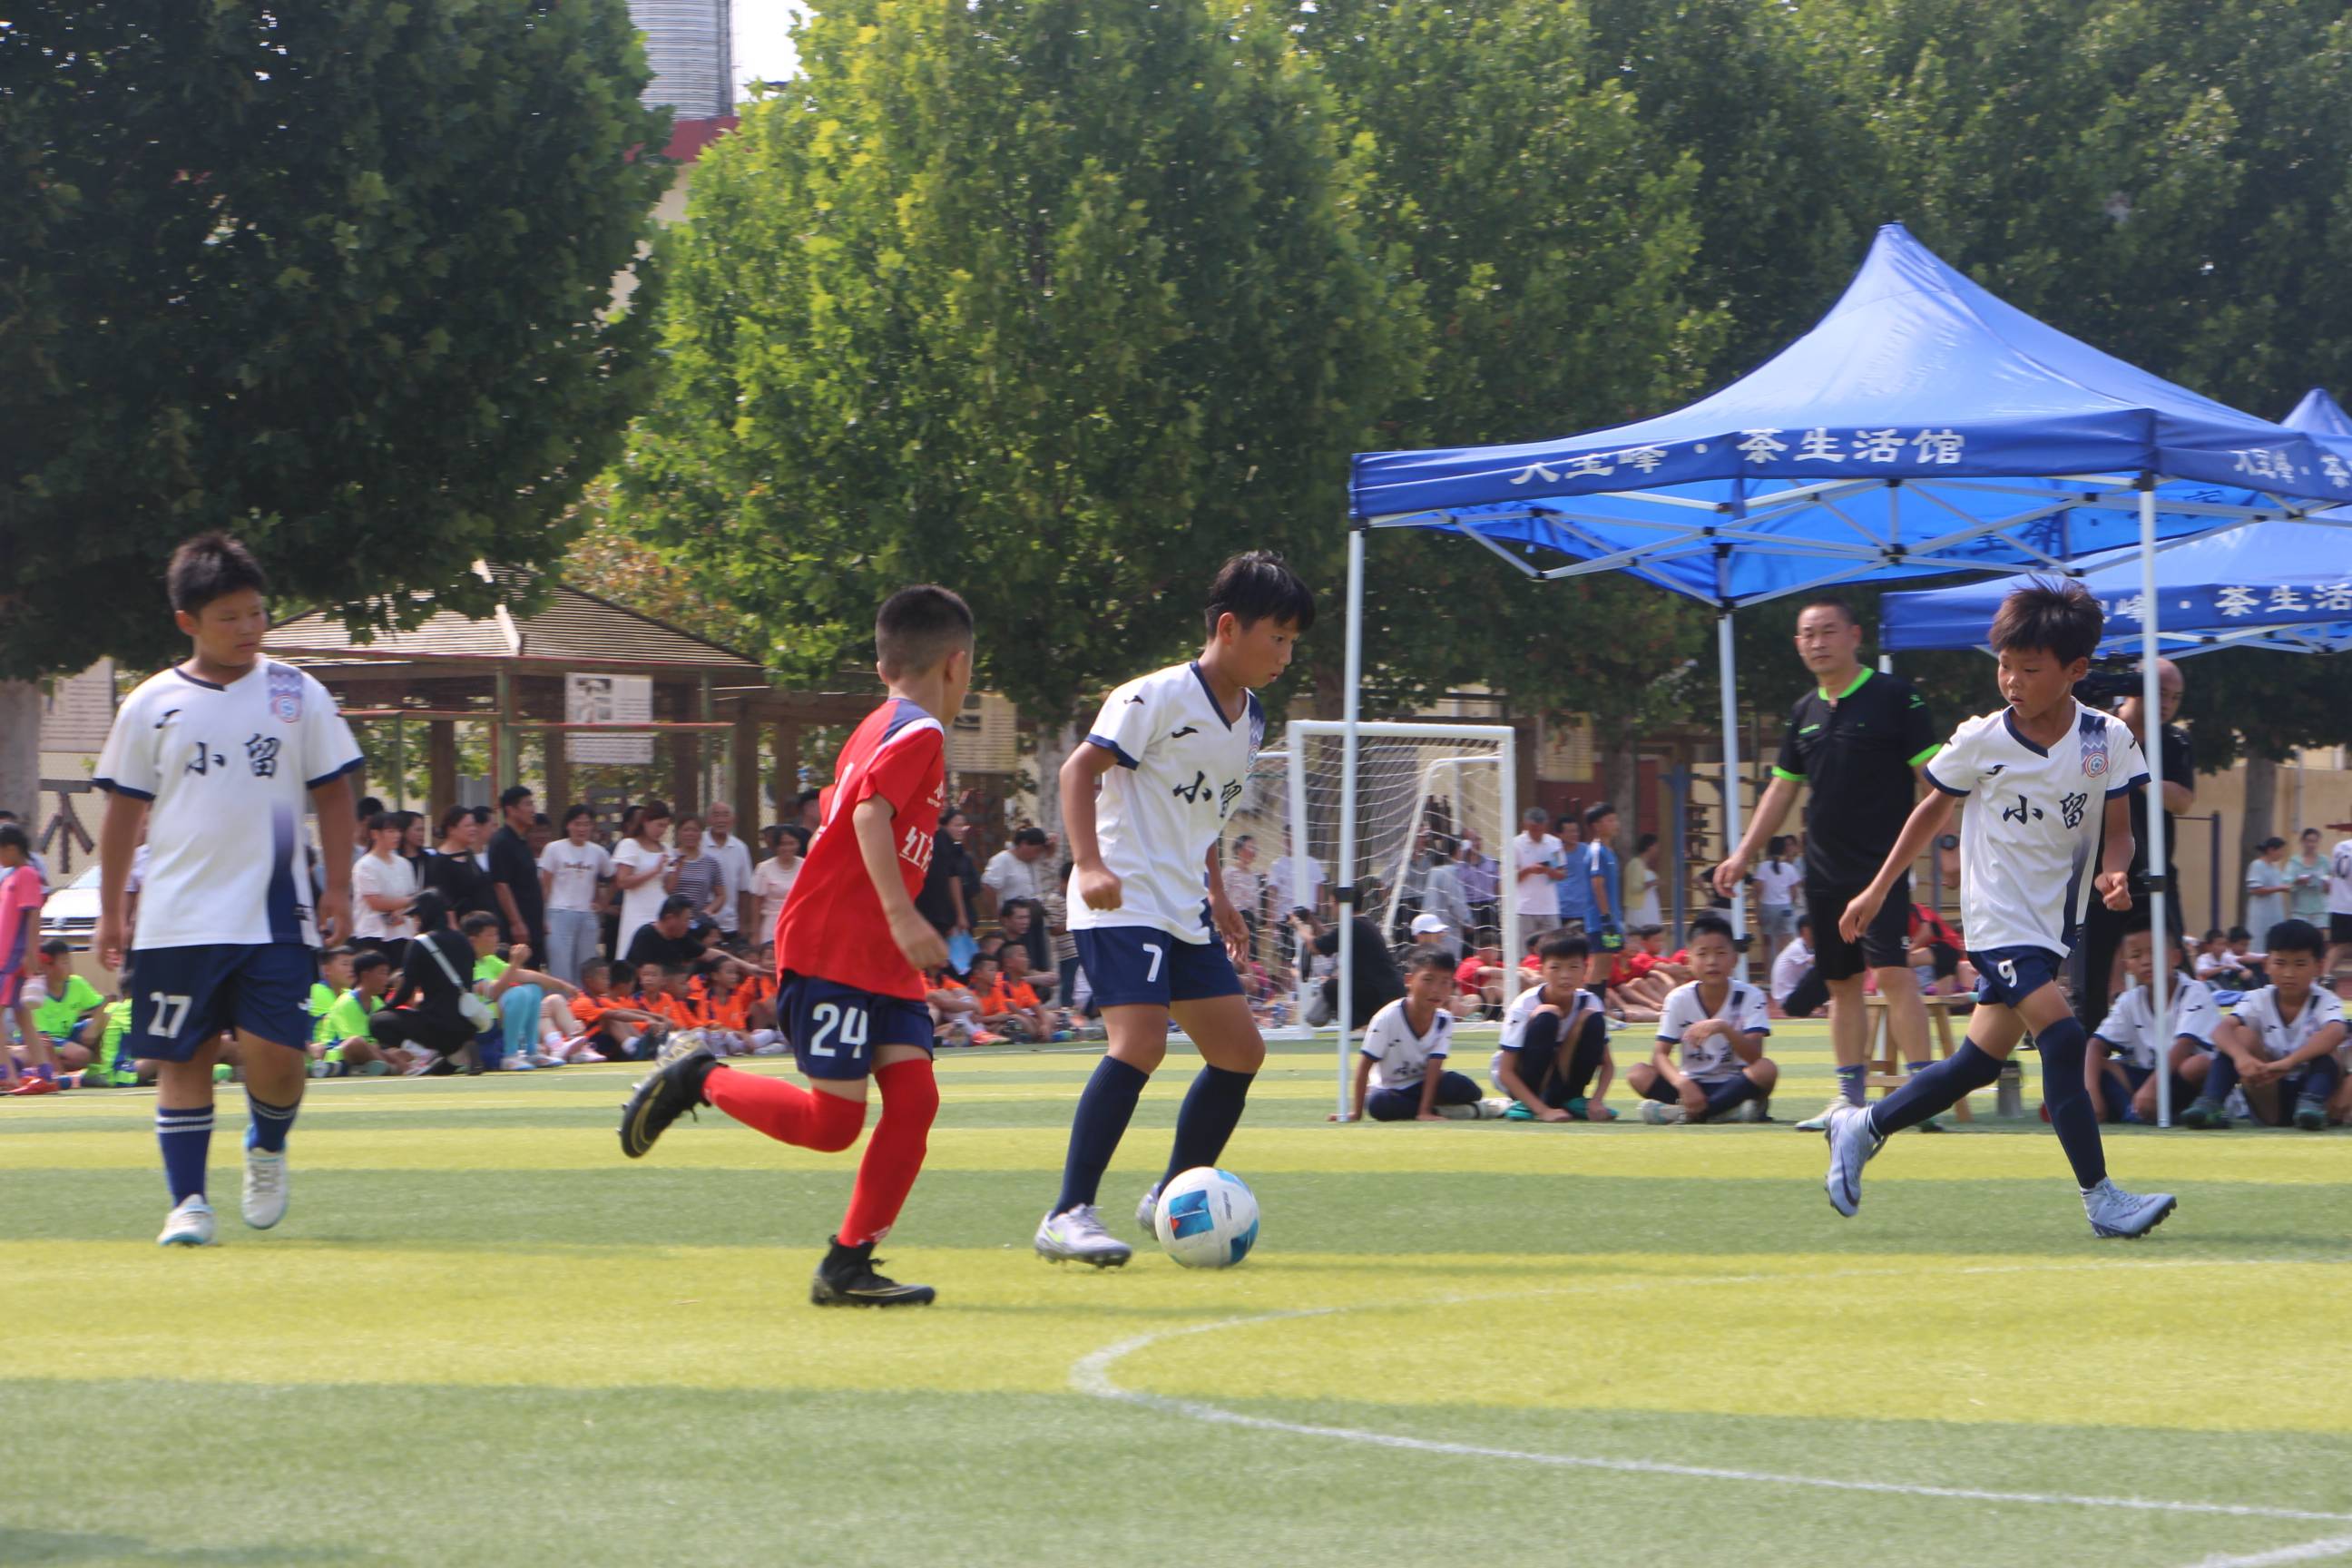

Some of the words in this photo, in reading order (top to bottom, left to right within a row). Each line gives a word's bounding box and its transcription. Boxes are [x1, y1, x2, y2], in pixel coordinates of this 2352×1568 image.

[184, 733, 281, 779] 小留
[2003, 792, 2088, 829] 小留
[1143, 944, 1162, 982] 7
[1998, 960, 2017, 988] 9
[147, 991, 192, 1039] 27
[809, 1003, 868, 1059] 24
